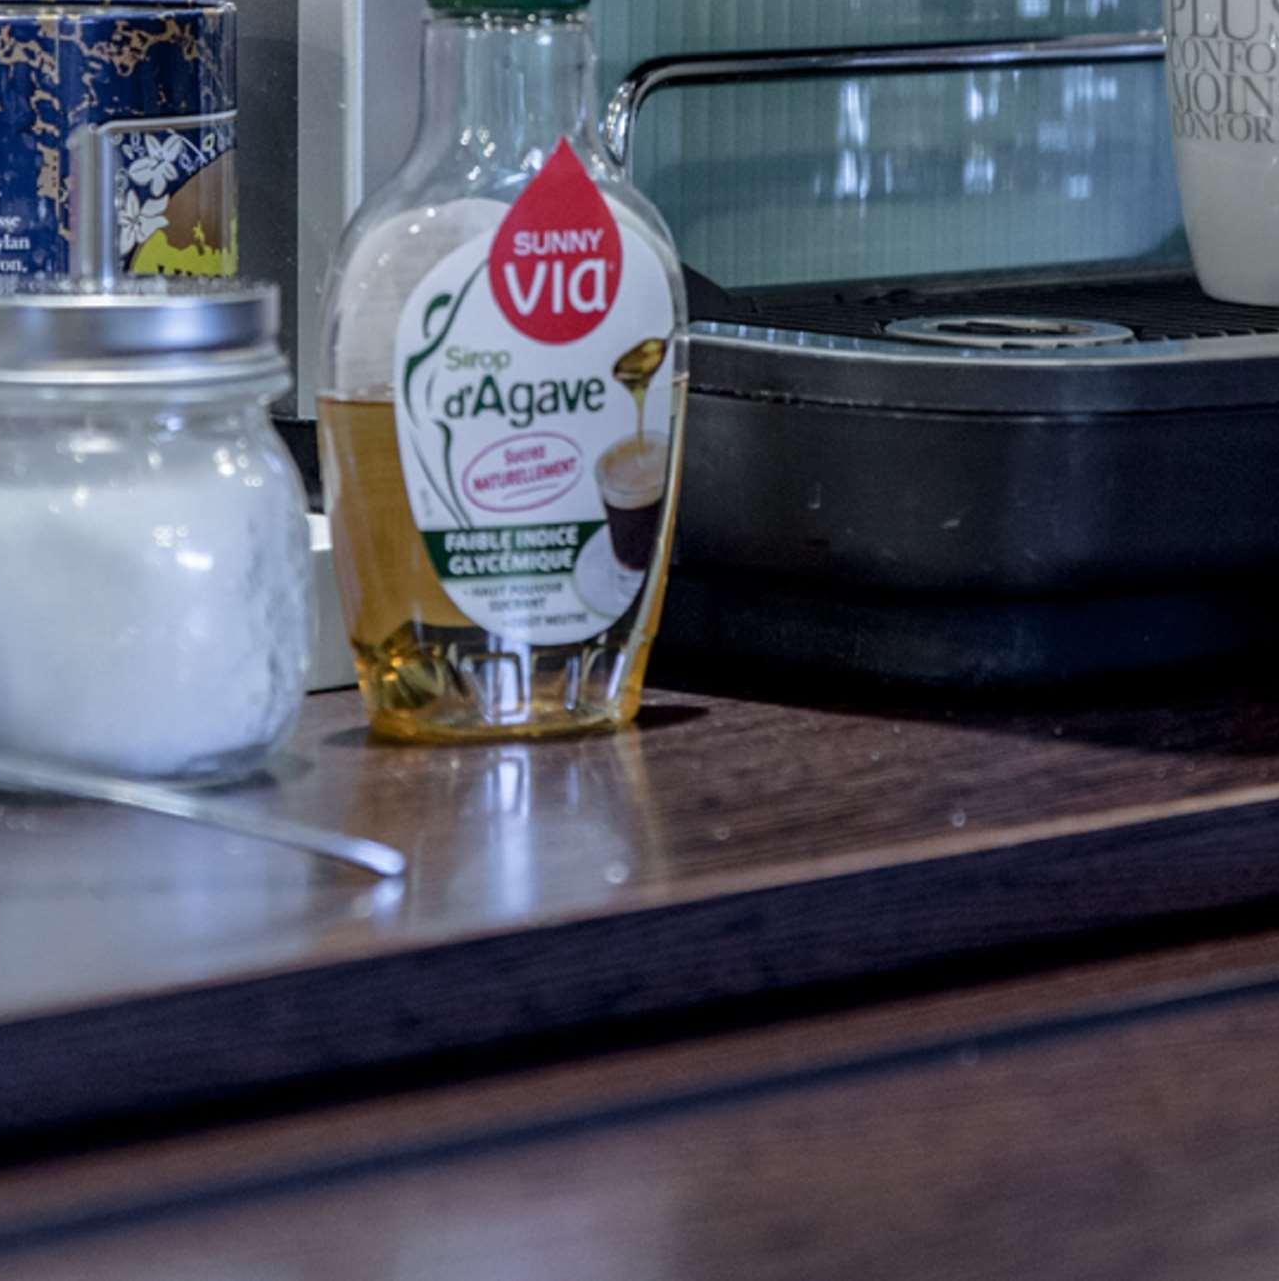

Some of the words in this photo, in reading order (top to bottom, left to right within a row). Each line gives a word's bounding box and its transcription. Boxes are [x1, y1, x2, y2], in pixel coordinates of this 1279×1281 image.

[513, 227, 604, 256] SUNNY
[445, 345, 512, 373] Sirop
[443, 373, 606, 430] d'Agave
[444, 531, 514, 553] FAIBLE
[515, 524, 580, 549] INDICE
